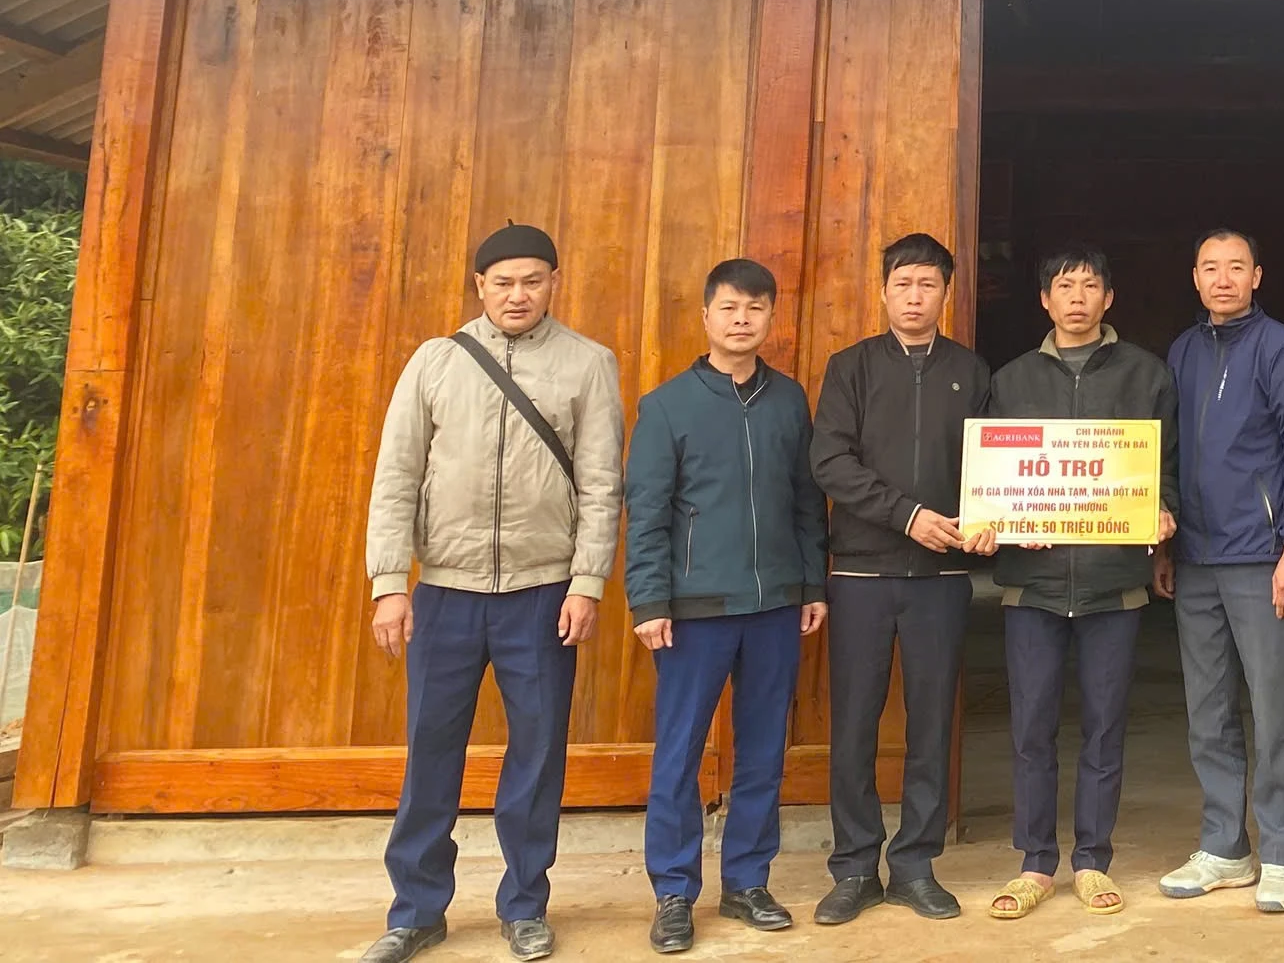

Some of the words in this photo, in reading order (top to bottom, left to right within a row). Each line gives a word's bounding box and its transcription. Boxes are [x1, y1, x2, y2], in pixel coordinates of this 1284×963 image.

[1076, 428, 1091, 436] CHI
[993, 434, 1040, 442] AGRIBANK
[1018, 453, 1050, 477] HỖ
[1059, 458, 1104, 481] TRỢ
[986, 487, 1000, 496] GIA
[1028, 485, 1045, 496] XÓA
[1026, 502, 1056, 511] PHONG
[1042, 521, 1057, 533] 50
[1060, 518, 1094, 536] TRIỆU
